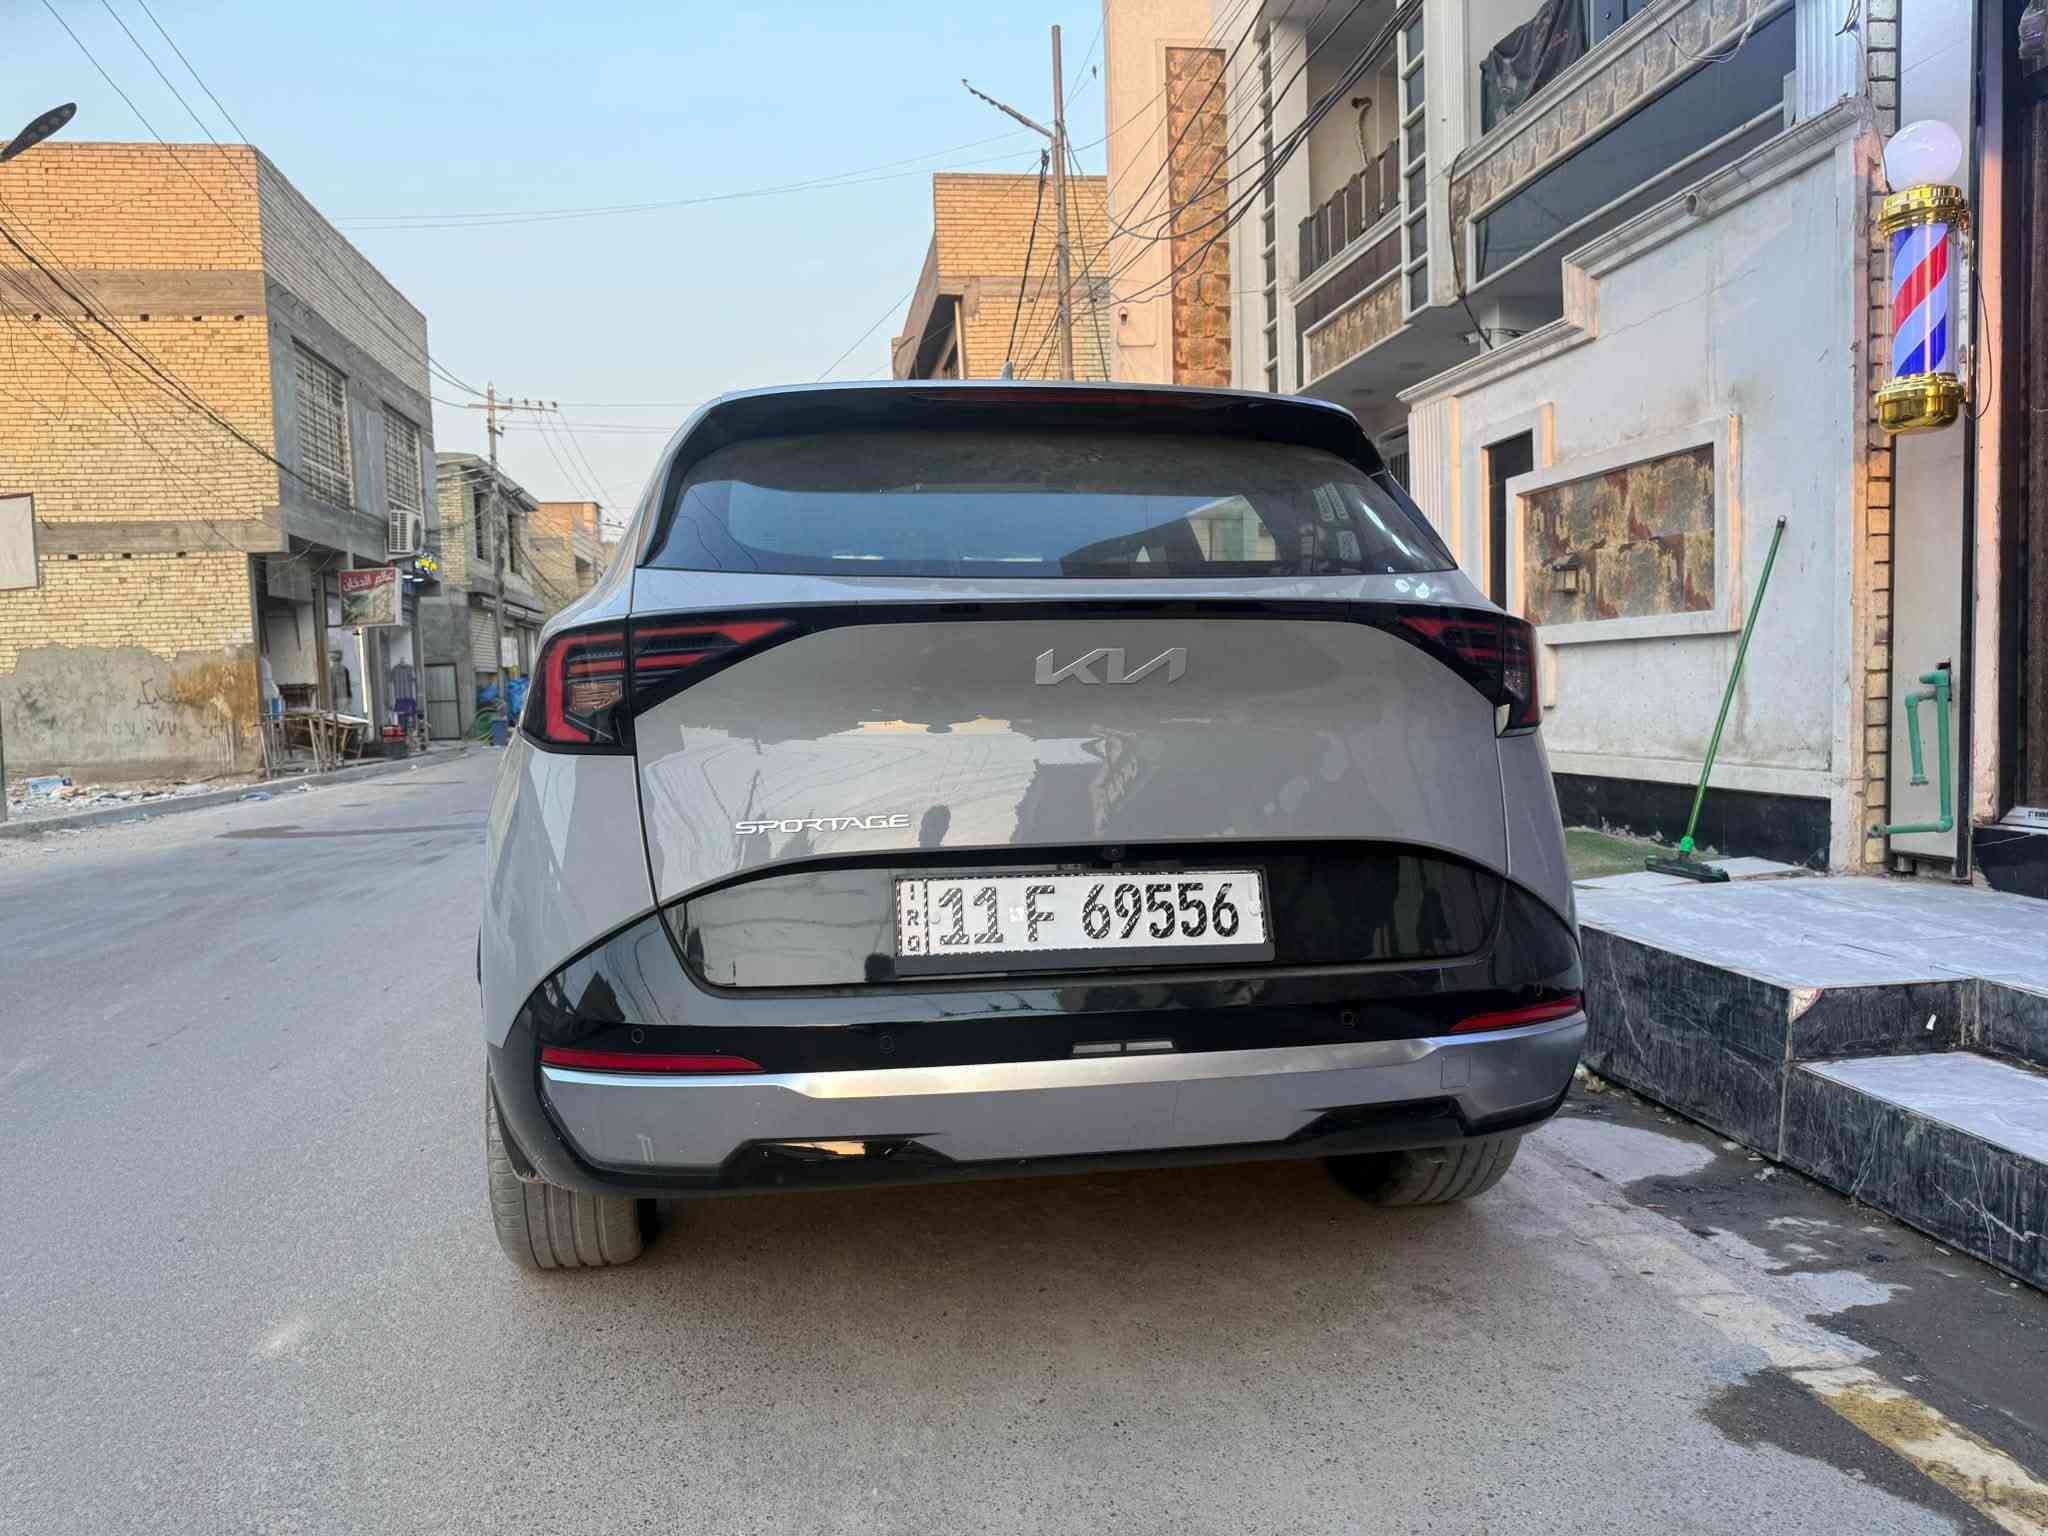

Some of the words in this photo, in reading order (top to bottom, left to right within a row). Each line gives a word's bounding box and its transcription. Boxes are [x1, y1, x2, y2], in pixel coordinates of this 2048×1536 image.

[1035, 647, 1187, 685] KIA
[736, 814, 909, 835] SPORTAGE
[938, 886, 1004, 945] 11
[1025, 884, 1055, 943] F
[1082, 883, 1240, 939] 69556
